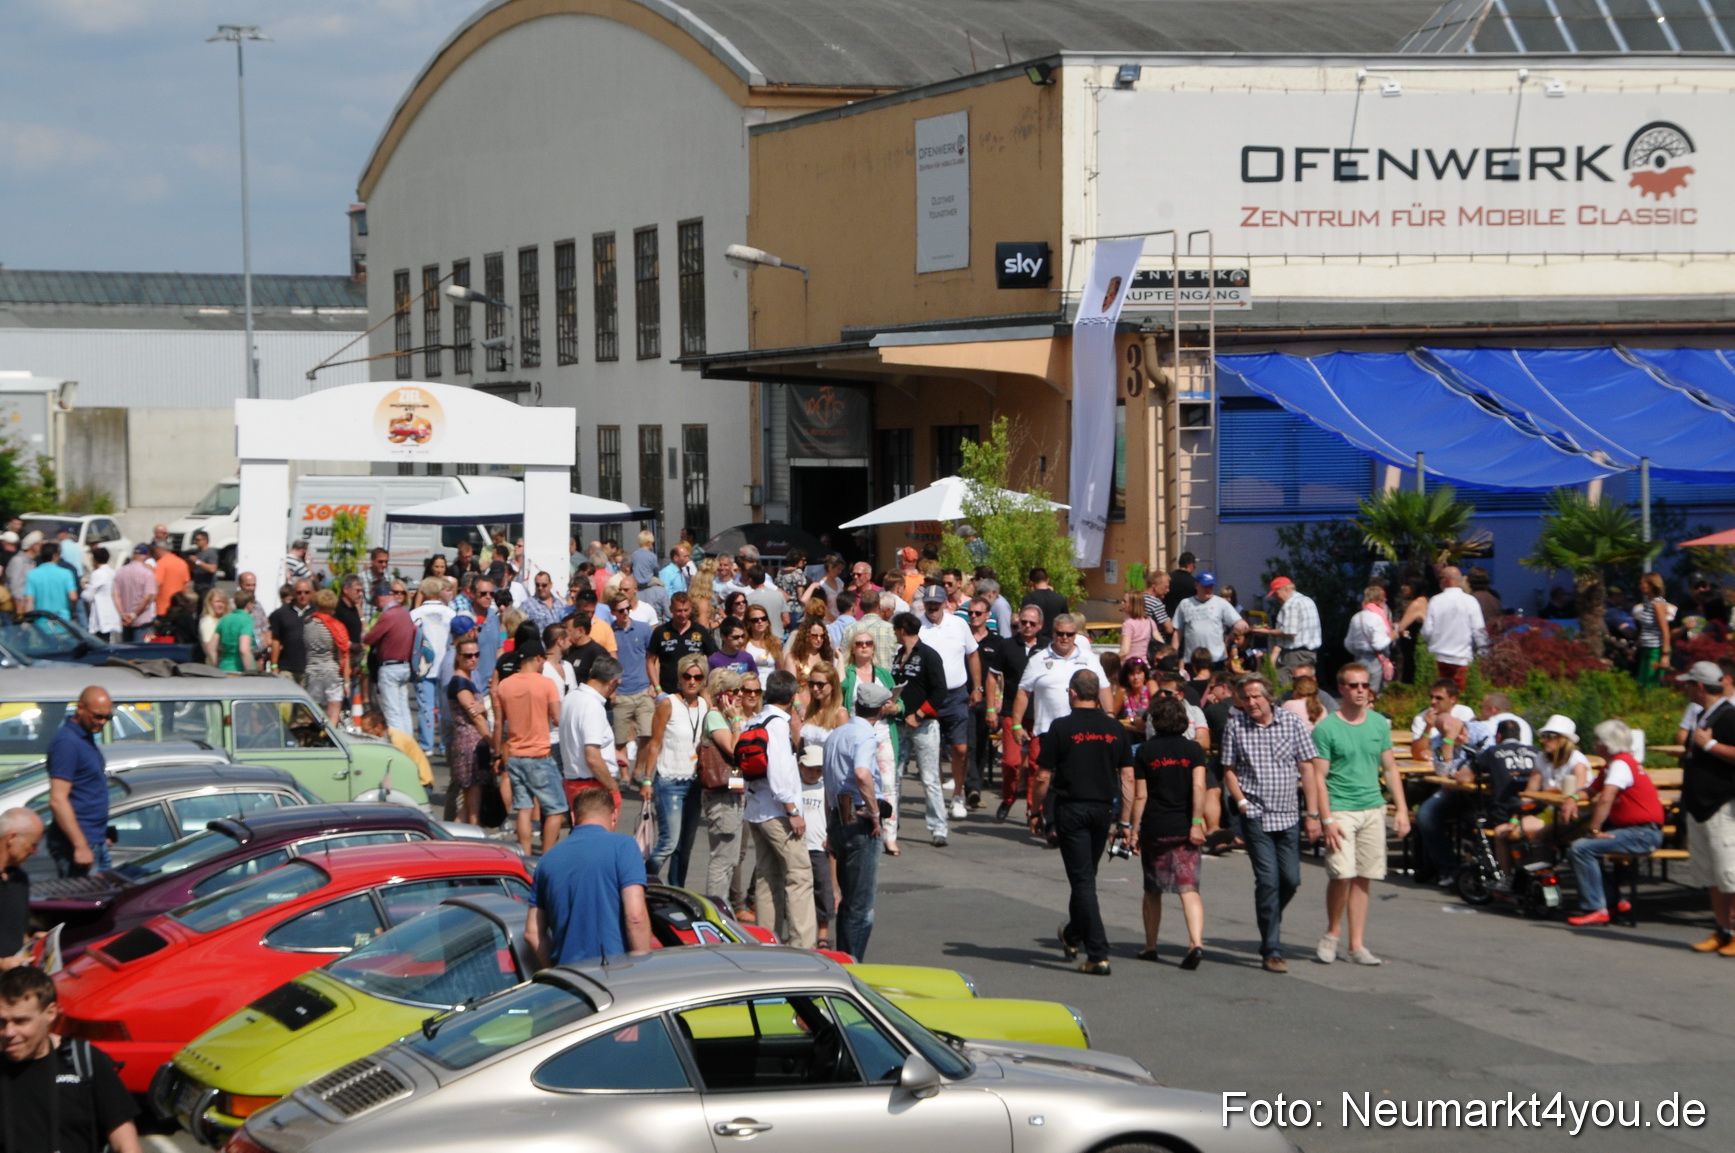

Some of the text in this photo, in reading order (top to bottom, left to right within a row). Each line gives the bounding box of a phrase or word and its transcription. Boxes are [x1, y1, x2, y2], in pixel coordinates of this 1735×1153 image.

[1240, 144, 1615, 183] OFENWERK
[1240, 203, 1698, 227] ZENTRUM FÜR MOBILE CLASSIC
[1004, 252, 1043, 278] sky
[1133, 270, 1228, 280] ENWERK
[1124, 289, 1240, 301] AUPTENGANG
[1127, 344, 1143, 398] 3
